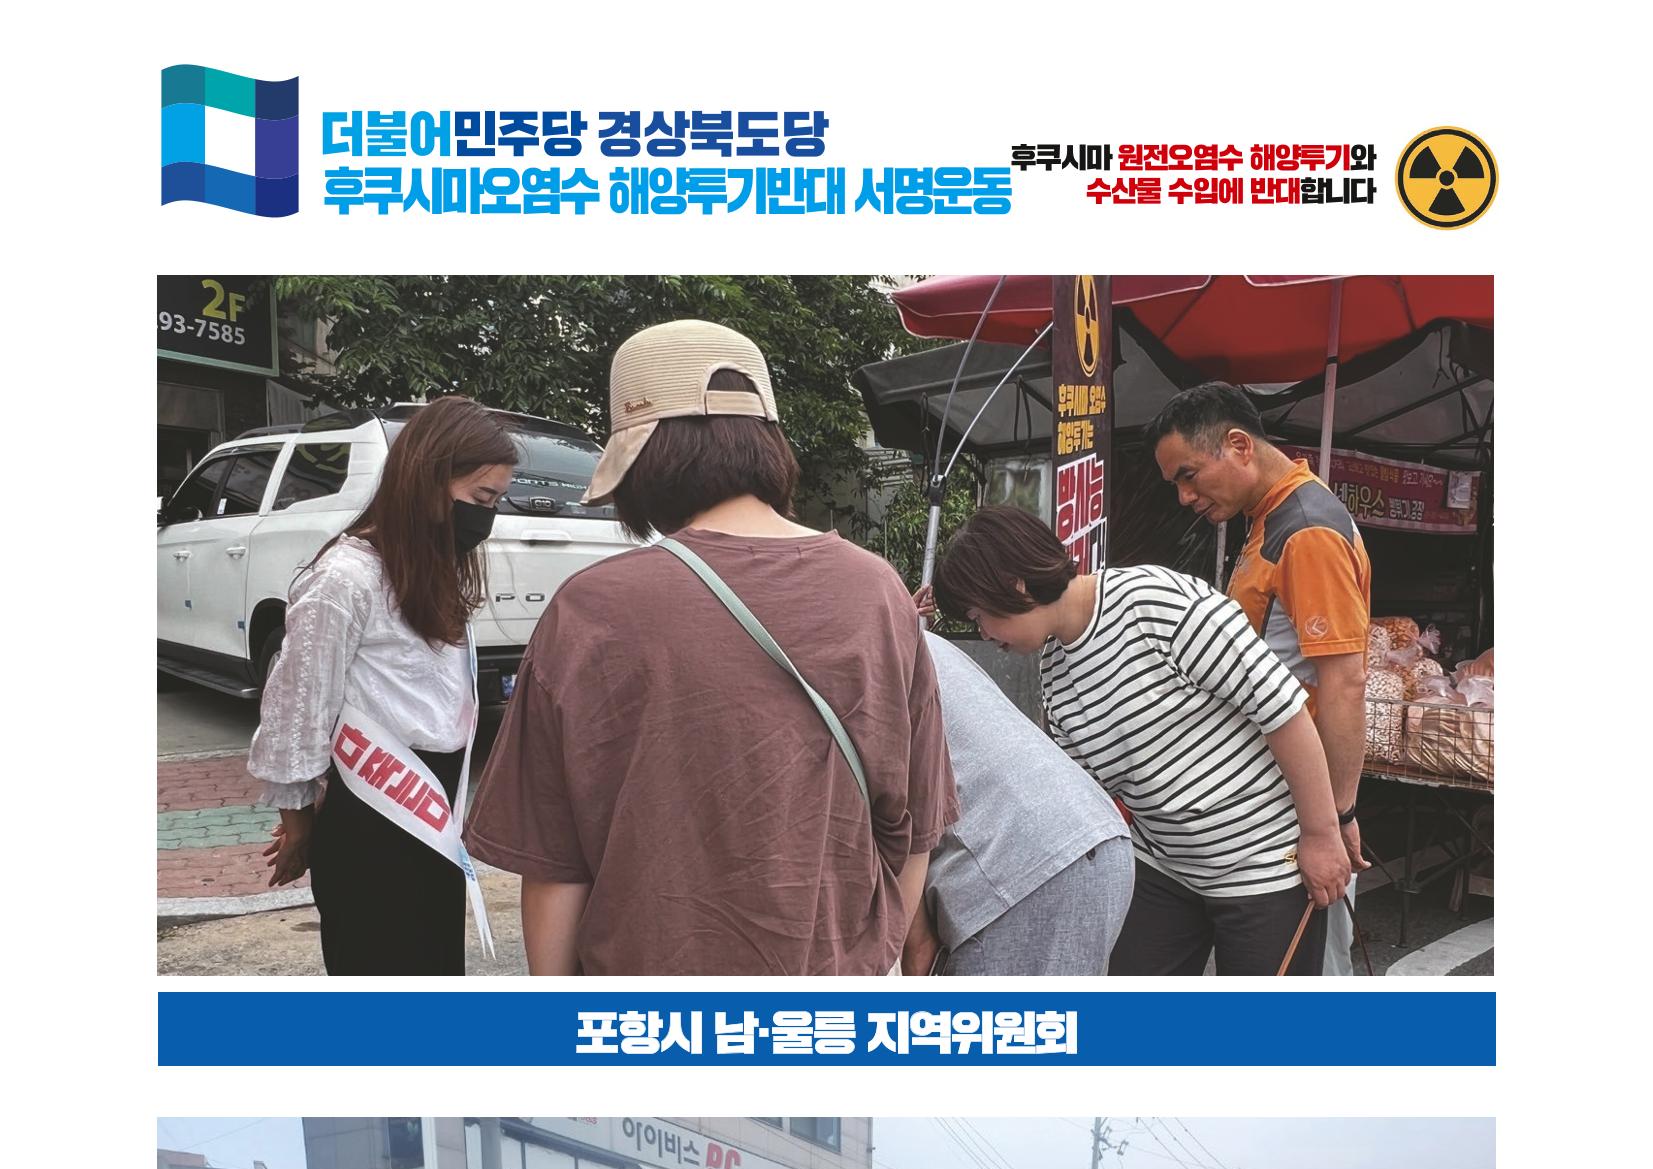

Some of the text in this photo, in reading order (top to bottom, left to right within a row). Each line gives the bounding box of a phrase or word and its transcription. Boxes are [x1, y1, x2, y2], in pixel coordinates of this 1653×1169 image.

[201, 278, 246, 322] 2F
[157, 311, 246, 345] 93-7585
[1056, 456, 1104, 543] 방사능
[622, 1117, 700, 1166] 아이비스
